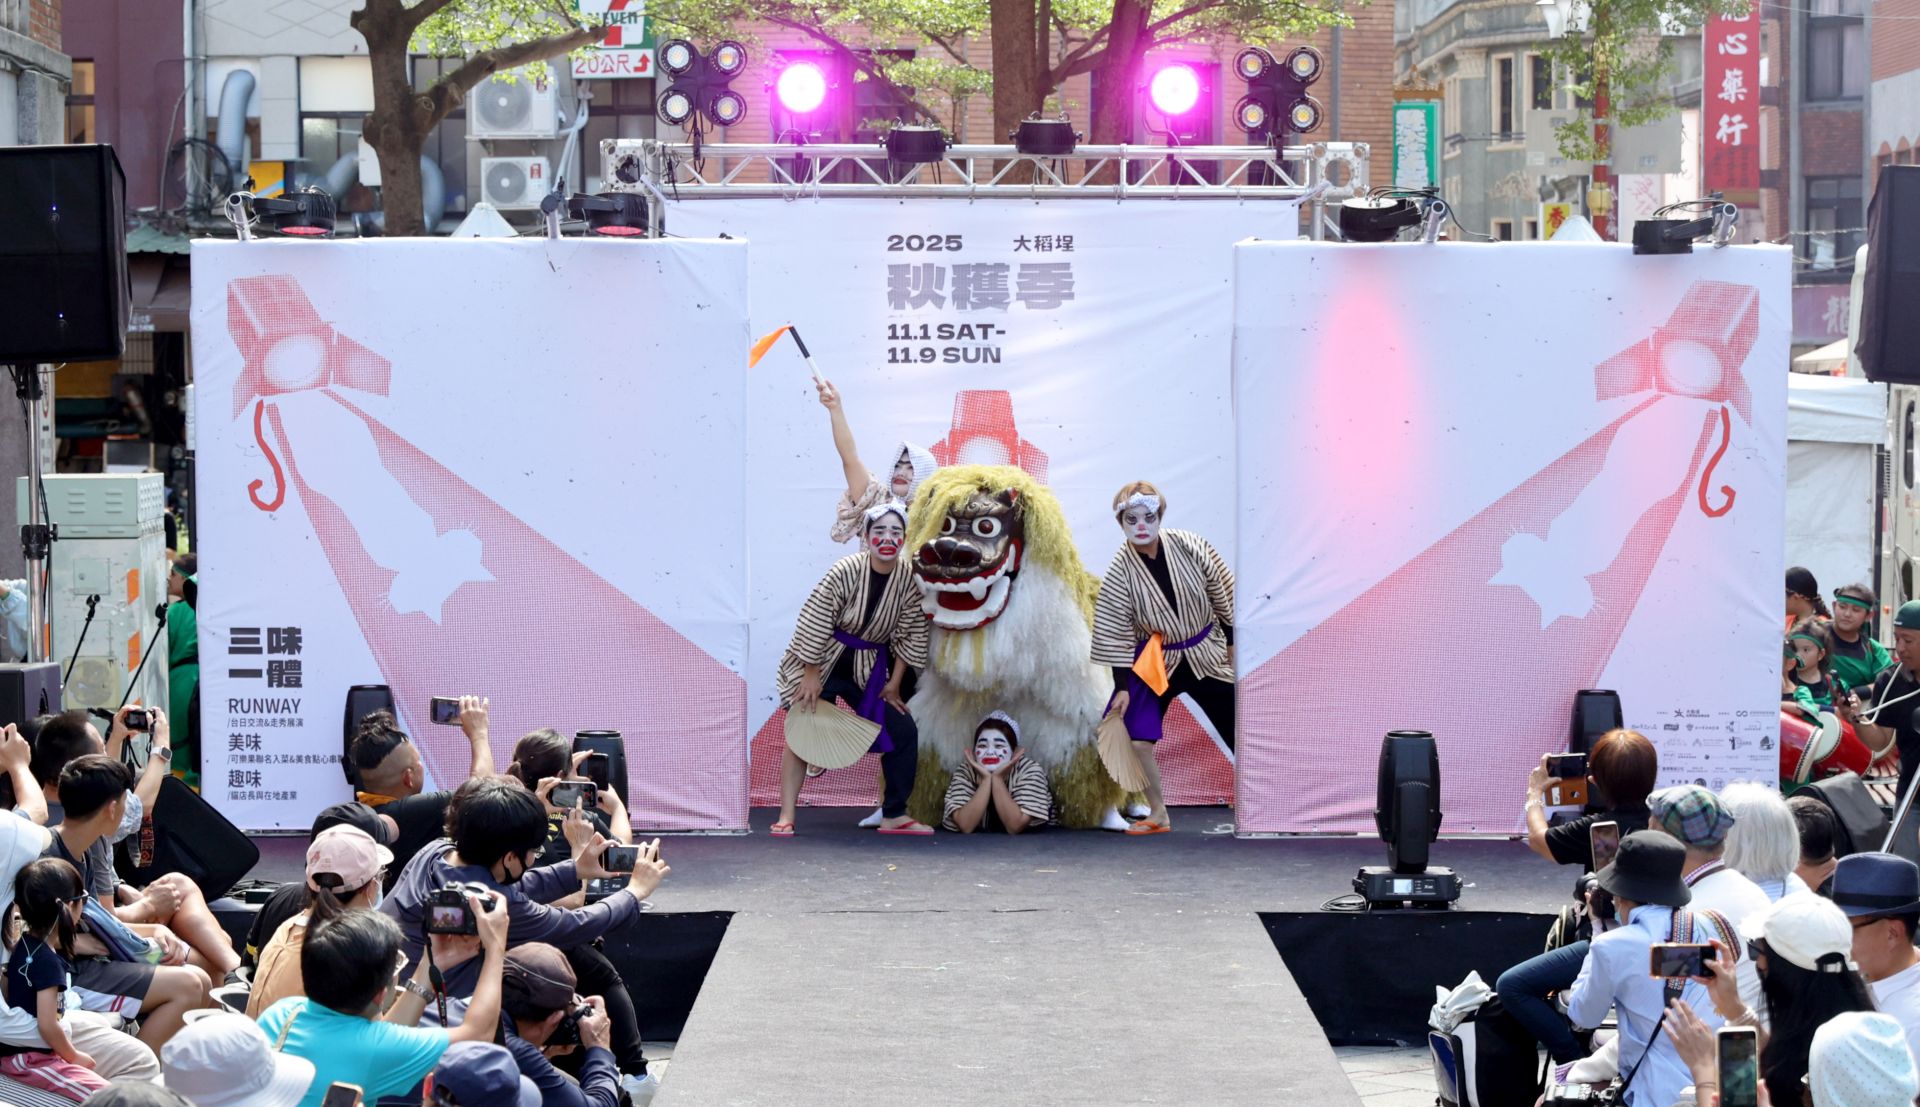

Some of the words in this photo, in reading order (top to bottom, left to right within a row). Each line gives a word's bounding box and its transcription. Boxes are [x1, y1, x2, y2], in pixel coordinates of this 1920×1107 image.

[575, 53, 631, 74] 20公尺
[1546, 206, 1567, 239] 香
[887, 234, 963, 252] 2025
[1013, 235, 1075, 252] 大稻埕
[887, 262, 1075, 312] 秋穫季
[888, 324, 931, 340] 11.1
[936, 323, 1006, 340] SAT-
[888, 347, 937, 363] 11.9
[942, 347, 1001, 363] SUN
[228, 626, 303, 655] 三味
[228, 659, 303, 688] 一體
[228, 698, 302, 714] RUNWAY
[228, 732, 262, 752] 美味
[228, 769, 262, 788] 趣味
